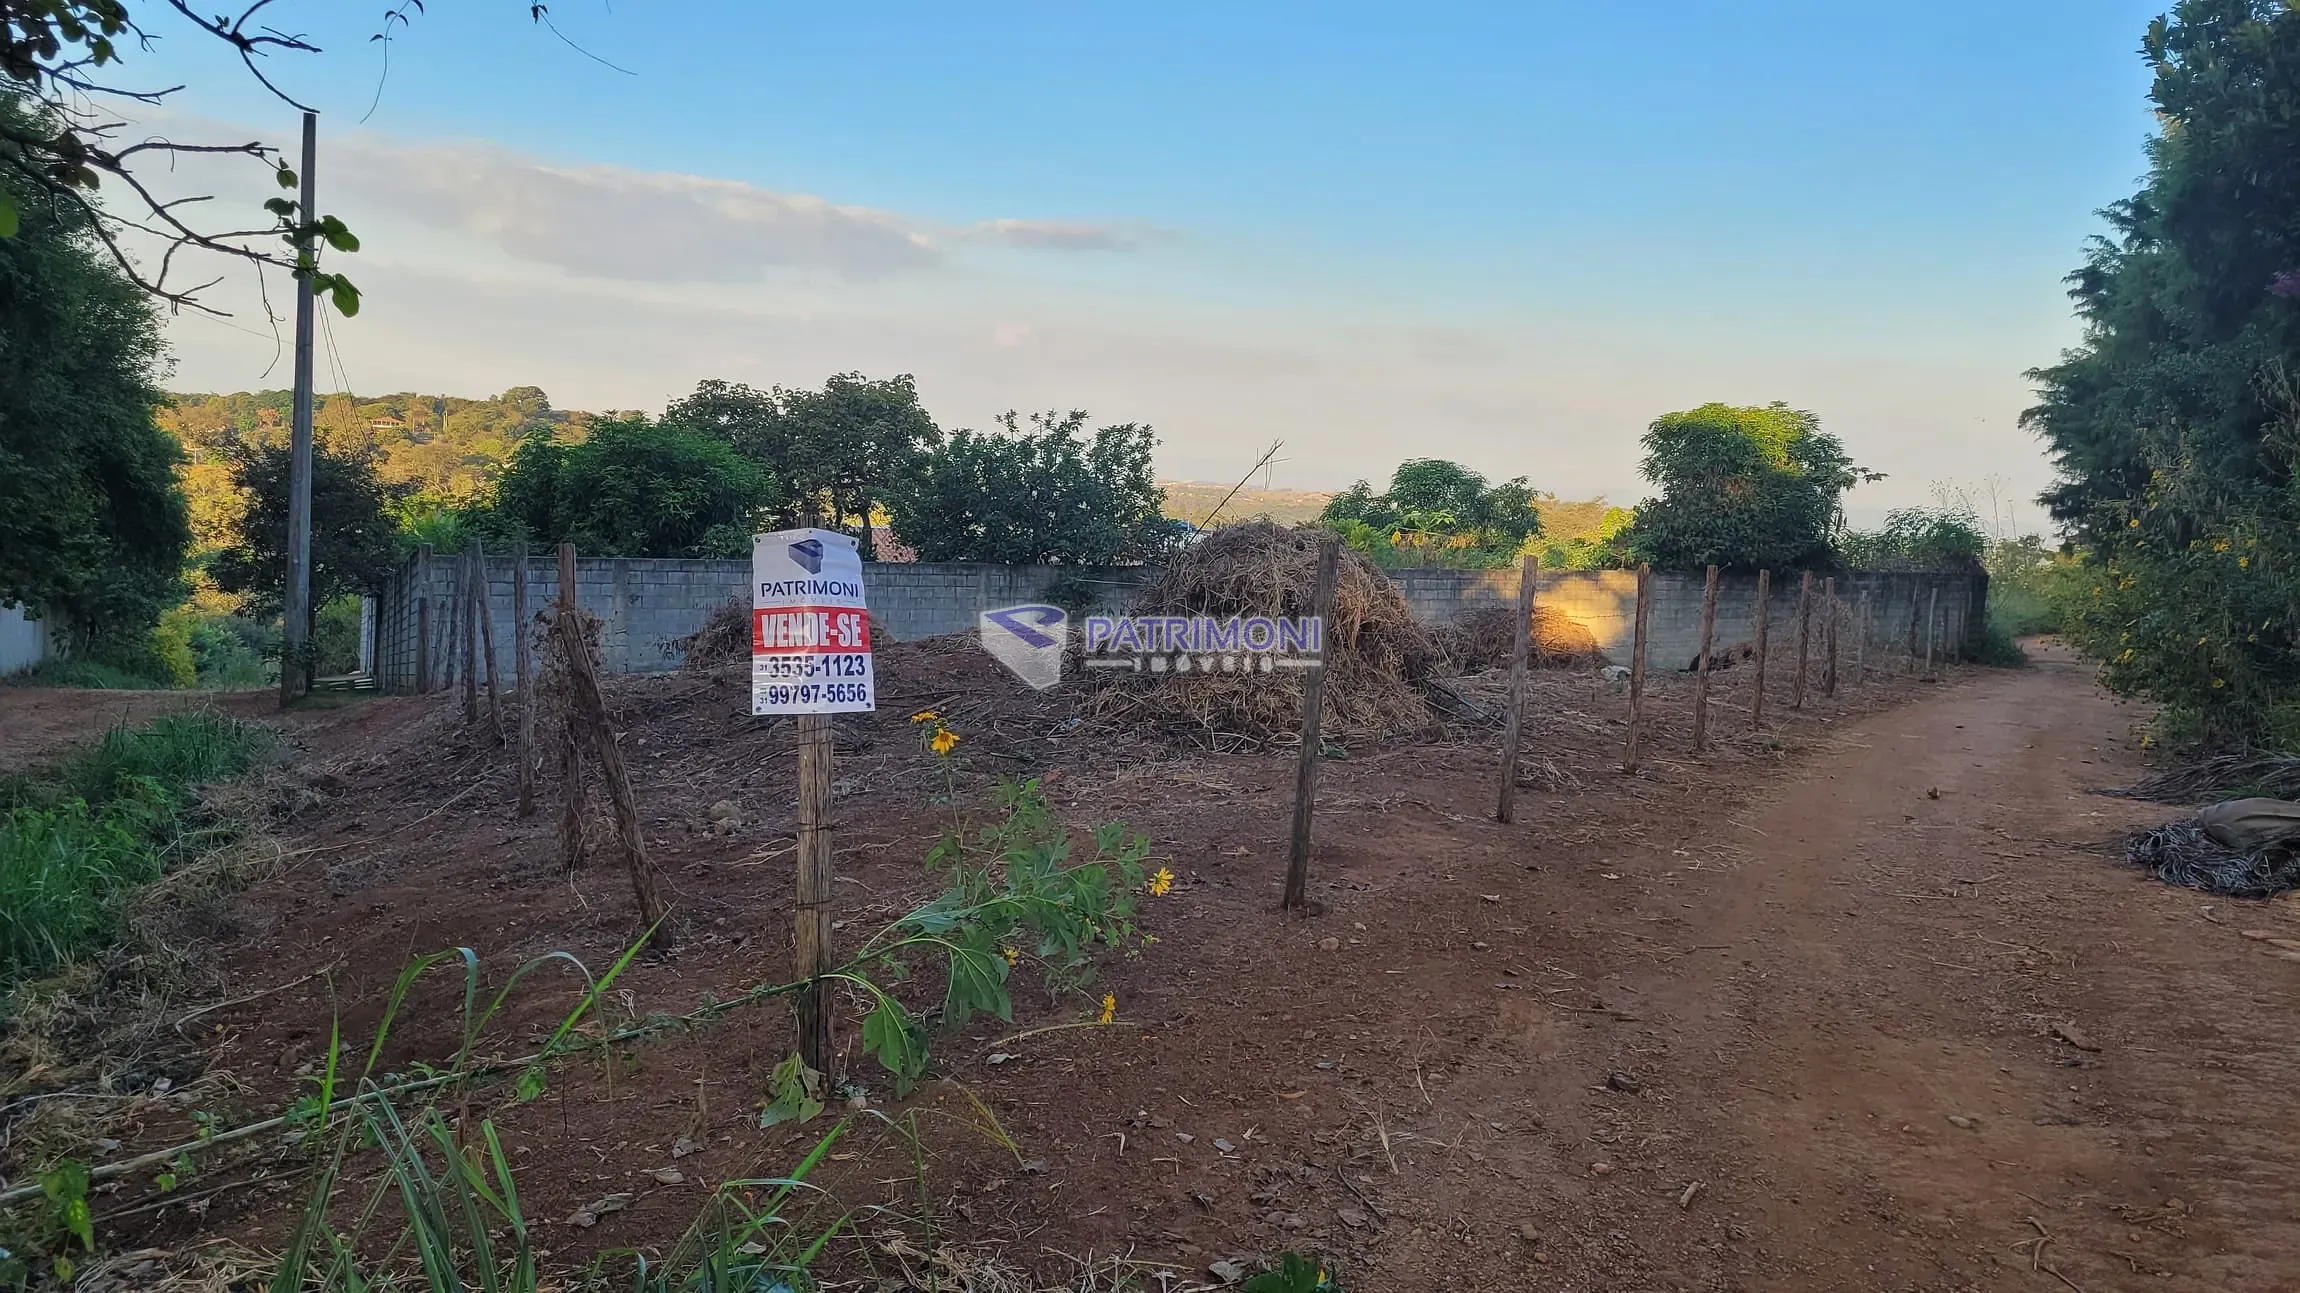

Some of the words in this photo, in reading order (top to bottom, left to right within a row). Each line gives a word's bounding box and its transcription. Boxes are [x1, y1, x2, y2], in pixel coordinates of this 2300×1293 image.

[761, 580, 858, 597] PATRIMONI
[761, 613, 862, 647] VENDE-SE
[769, 655, 865, 677] 3535-1123
[769, 683, 866, 704] 99797-5656
